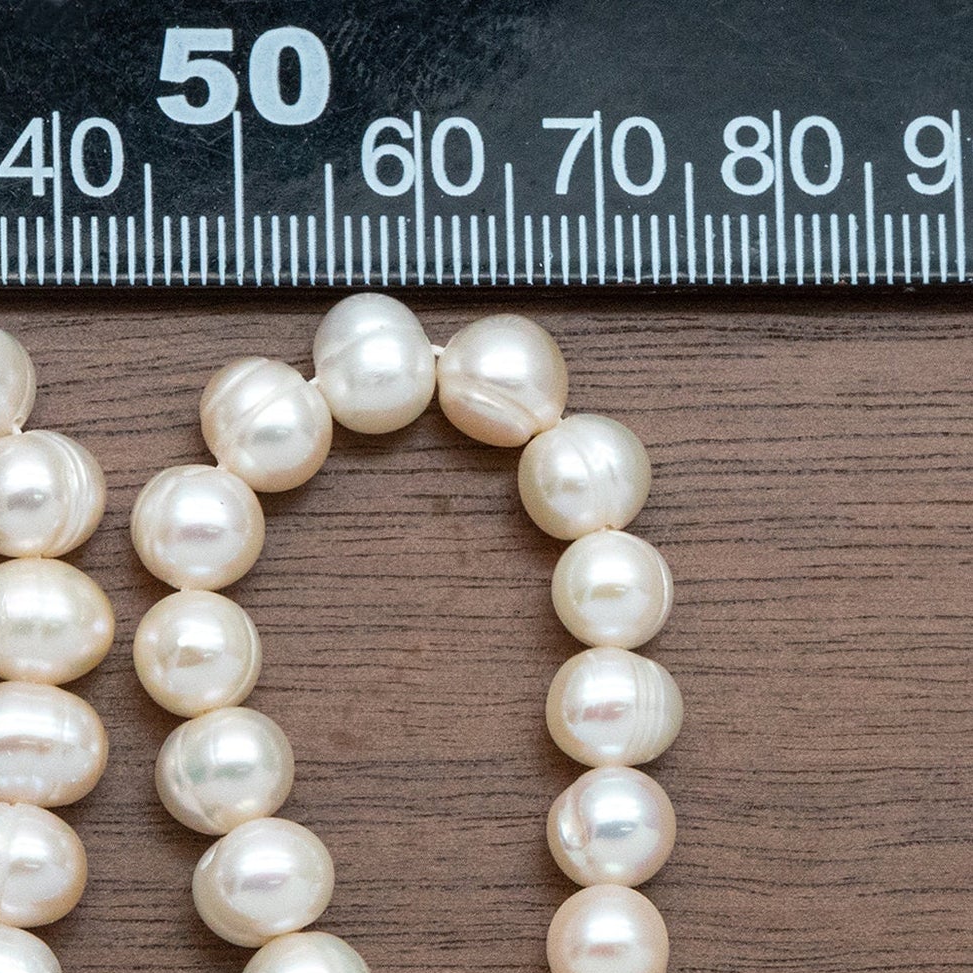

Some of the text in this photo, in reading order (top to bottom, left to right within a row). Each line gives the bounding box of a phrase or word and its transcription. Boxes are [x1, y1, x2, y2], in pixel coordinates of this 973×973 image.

[157, 26, 330, 125] 50
[362, 116, 484, 197] 60
[543, 116, 666, 196] 70
[721, 116, 843, 196] 80
